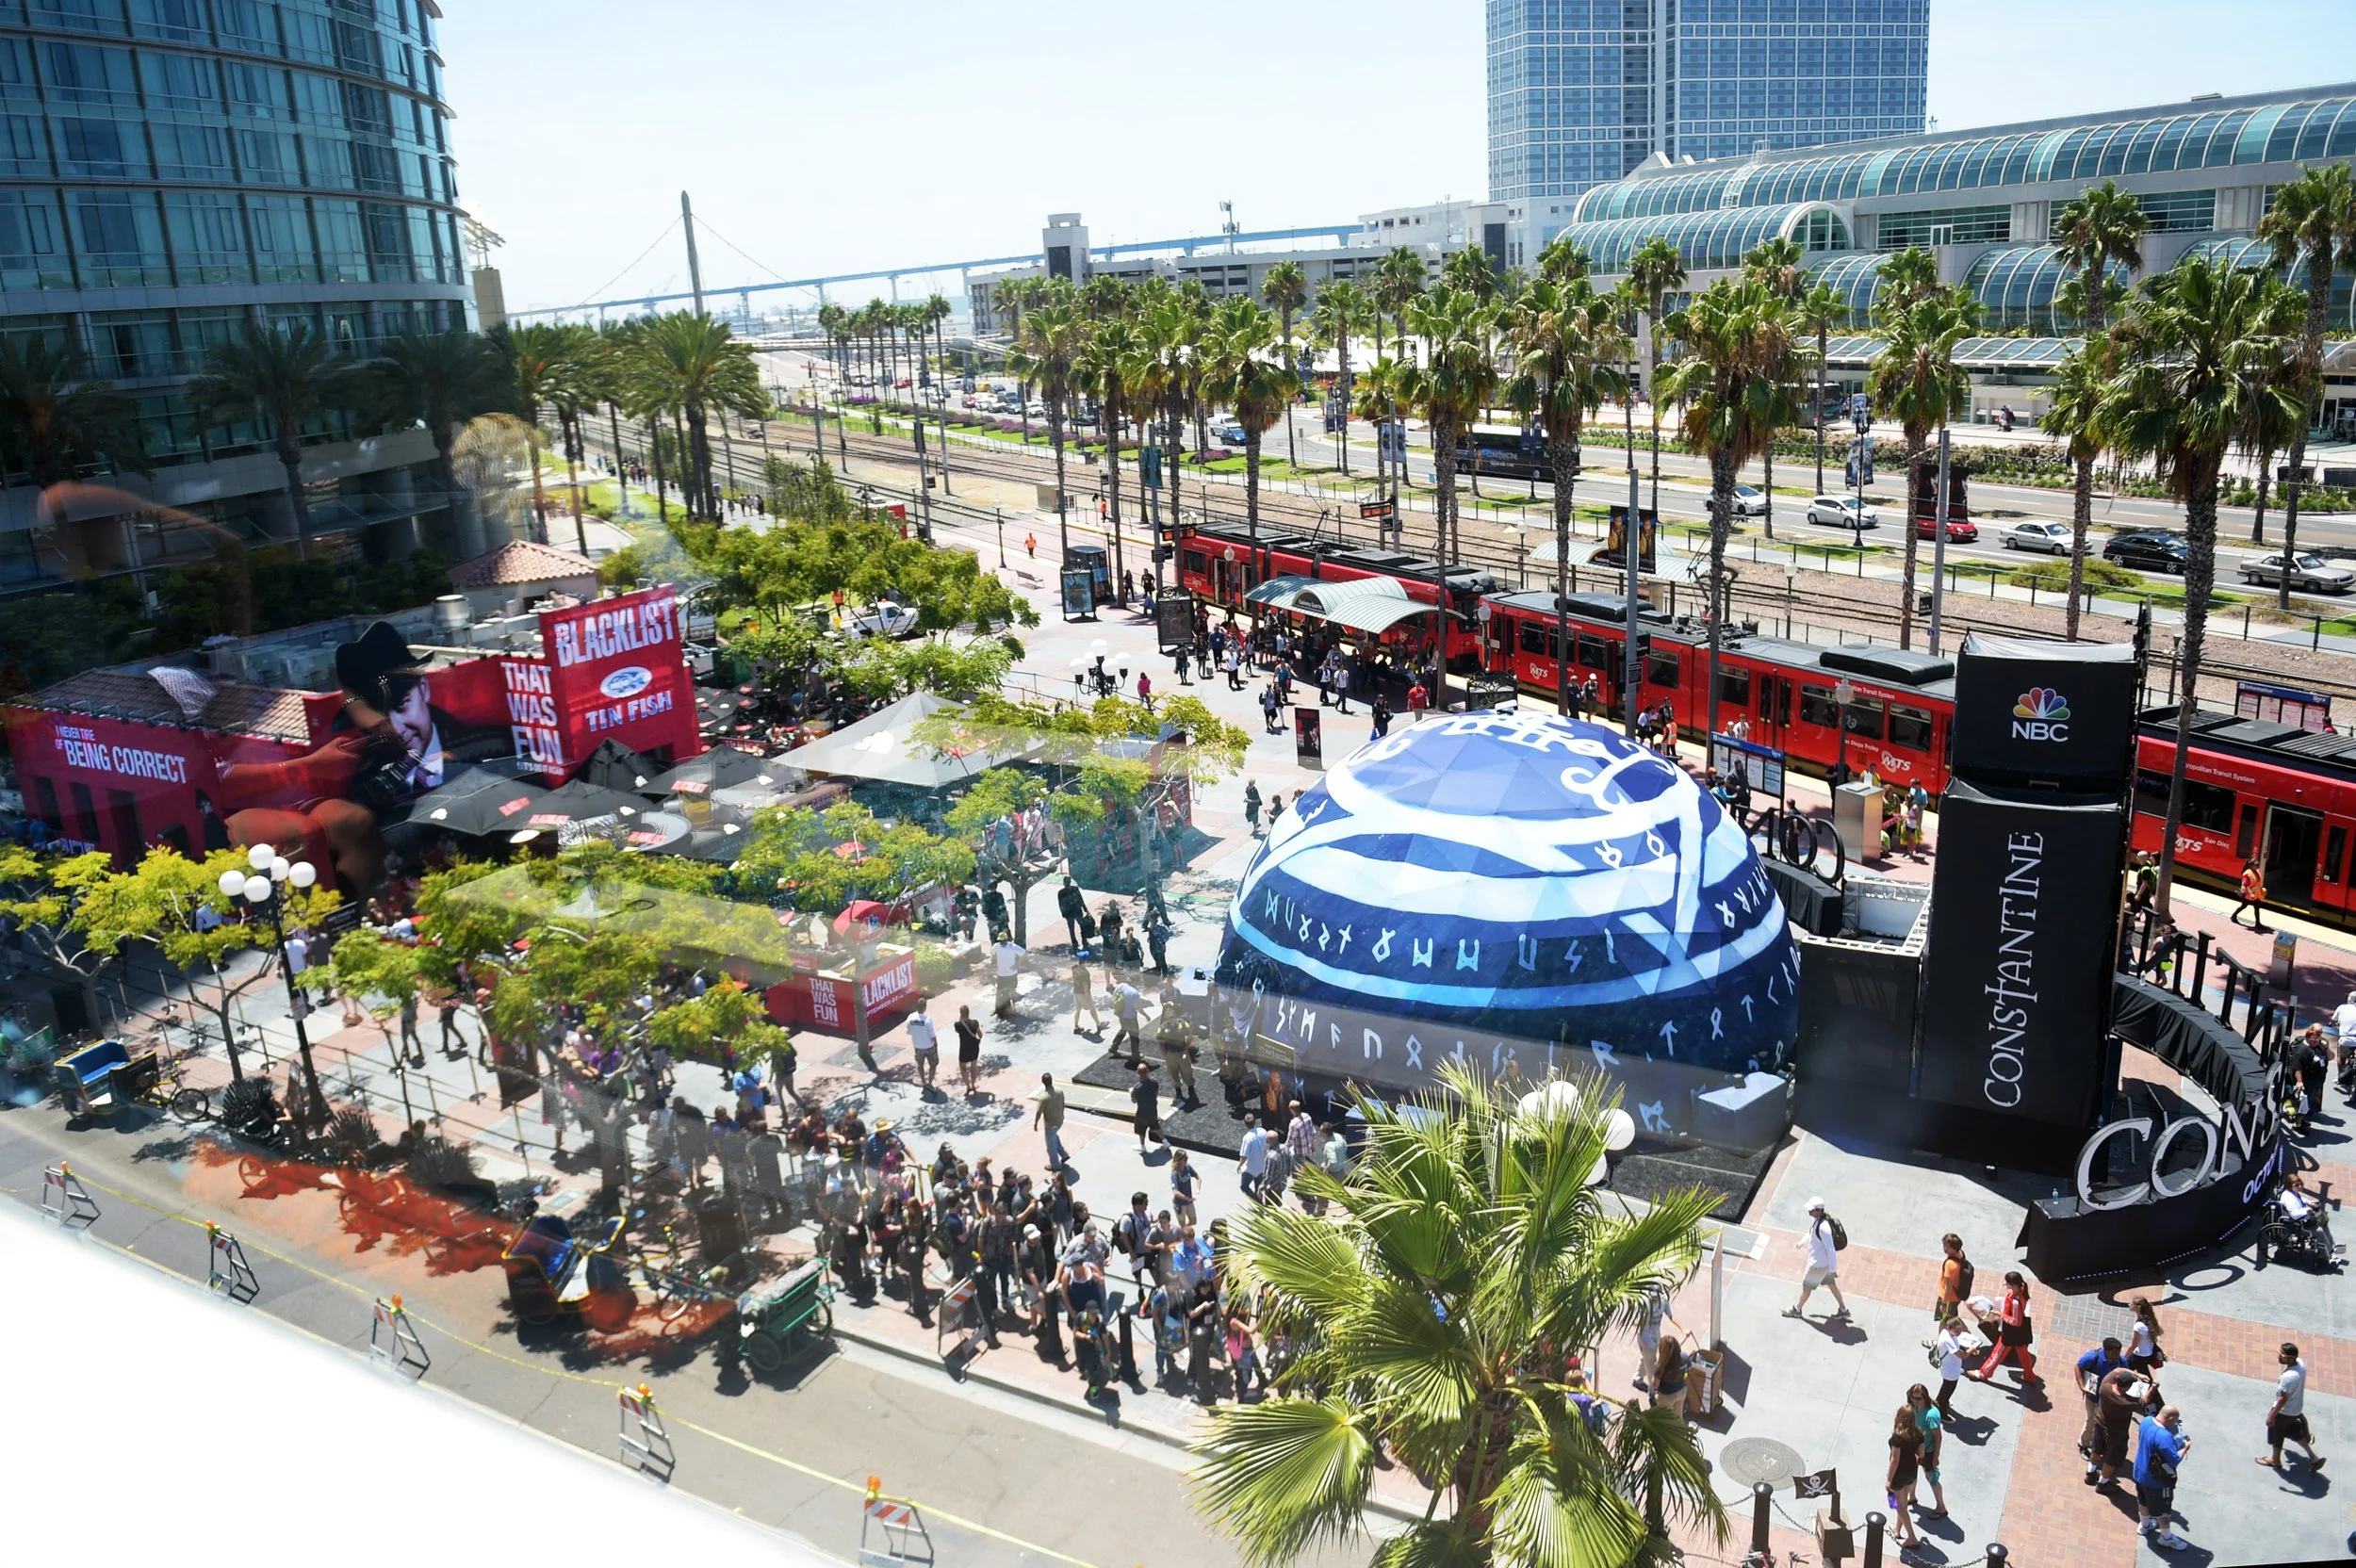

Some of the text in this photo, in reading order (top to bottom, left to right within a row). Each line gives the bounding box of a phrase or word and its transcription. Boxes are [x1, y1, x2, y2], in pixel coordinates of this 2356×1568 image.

[554, 597, 674, 667] BLACKLIST
[500, 662, 551, 694] THAT
[1863, 687, 1878, 696] Transit
[1878, 691, 1896, 700] System
[2245, 684, 2274, 694] Information
[506, 692, 558, 727] WAS
[585, 690, 674, 732] TIN FISH
[58, 727, 80, 740] NEVER
[80, 728, 95, 742] TIRE
[2012, 721, 2070, 743] NBC
[512, 725, 564, 765] FUN
[1850, 740, 1865, 750] Diego
[1865, 743, 1879, 753] Trolley
[55, 739, 187, 784] OF BEING CORRECT
[1881, 755, 1912, 772] MTS
[2213, 768, 2233, 778] Transit
[2233, 773, 2256, 784] System
[1984, 832, 2043, 1107] CONSTANTINE
[809, 977, 834, 993] THAT
[862, 959, 913, 1007] LACKLIST
[811, 990, 837, 1006] WAS
[813, 1004, 839, 1022] FUN
